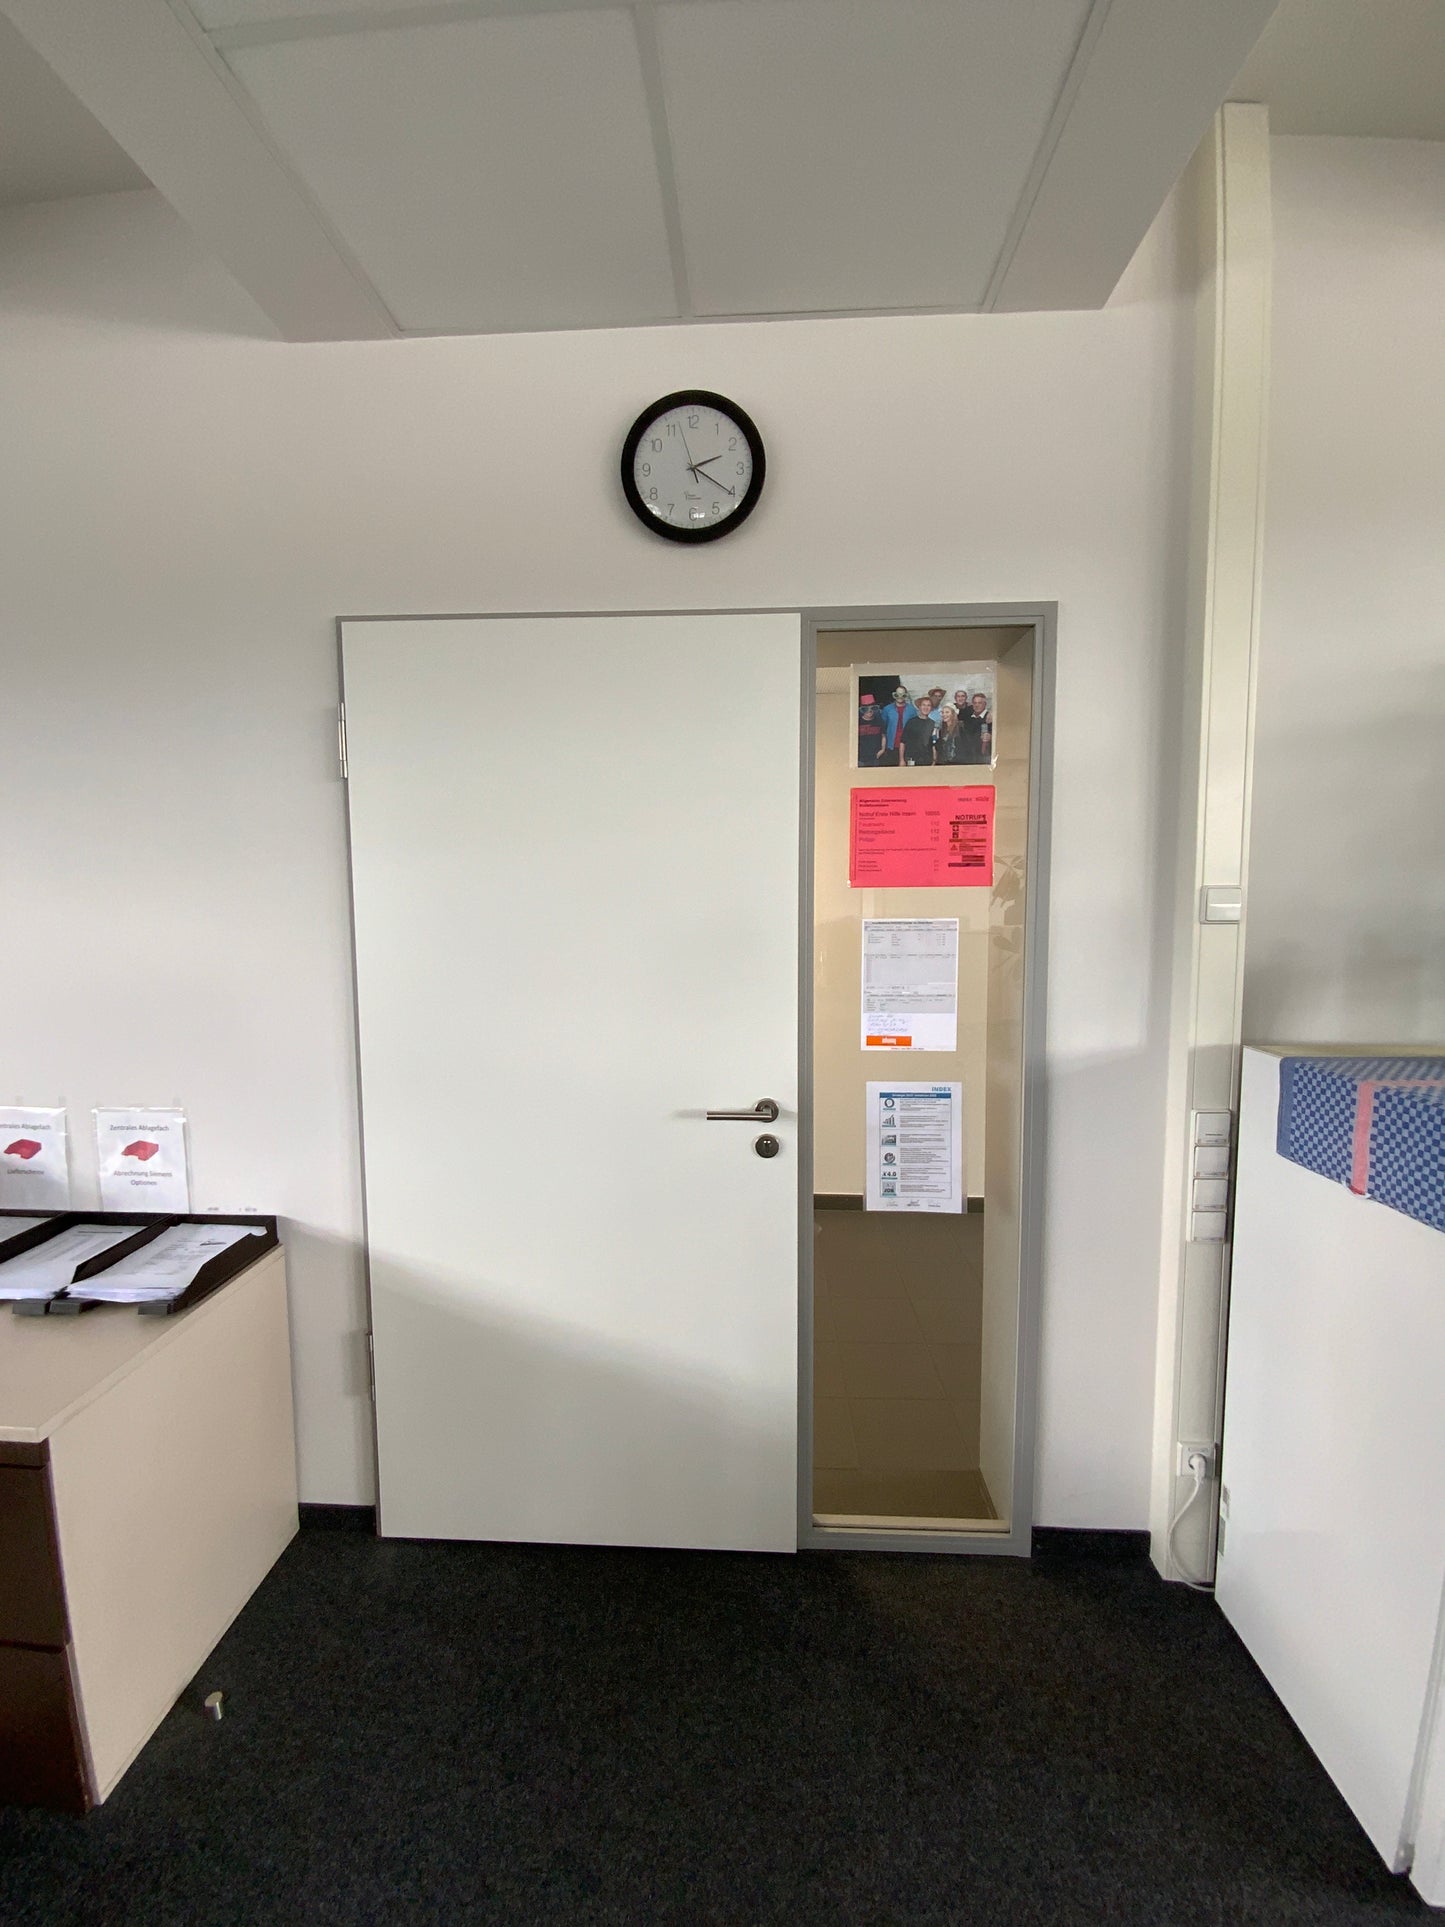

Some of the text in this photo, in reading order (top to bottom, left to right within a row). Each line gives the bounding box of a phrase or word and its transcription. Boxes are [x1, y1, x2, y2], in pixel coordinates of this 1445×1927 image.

[688, 414, 700, 429] 12
[666, 424, 676, 437] 11
[715, 423, 720, 436] 1
[651, 438, 663, 453] 10
[728, 437, 737, 451] 2
[642, 463, 651, 477] 9
[736, 461, 745, 475] 3
[649, 487, 658, 501] 8
[727, 486, 736, 498] 4
[667, 504, 675, 516] 7
[688, 507, 698, 521] 6
[712, 502, 720, 515] 5
[139, 1124, 170, 1132] Ablagefach
[113, 1170, 148, 1178] Abrechnung
